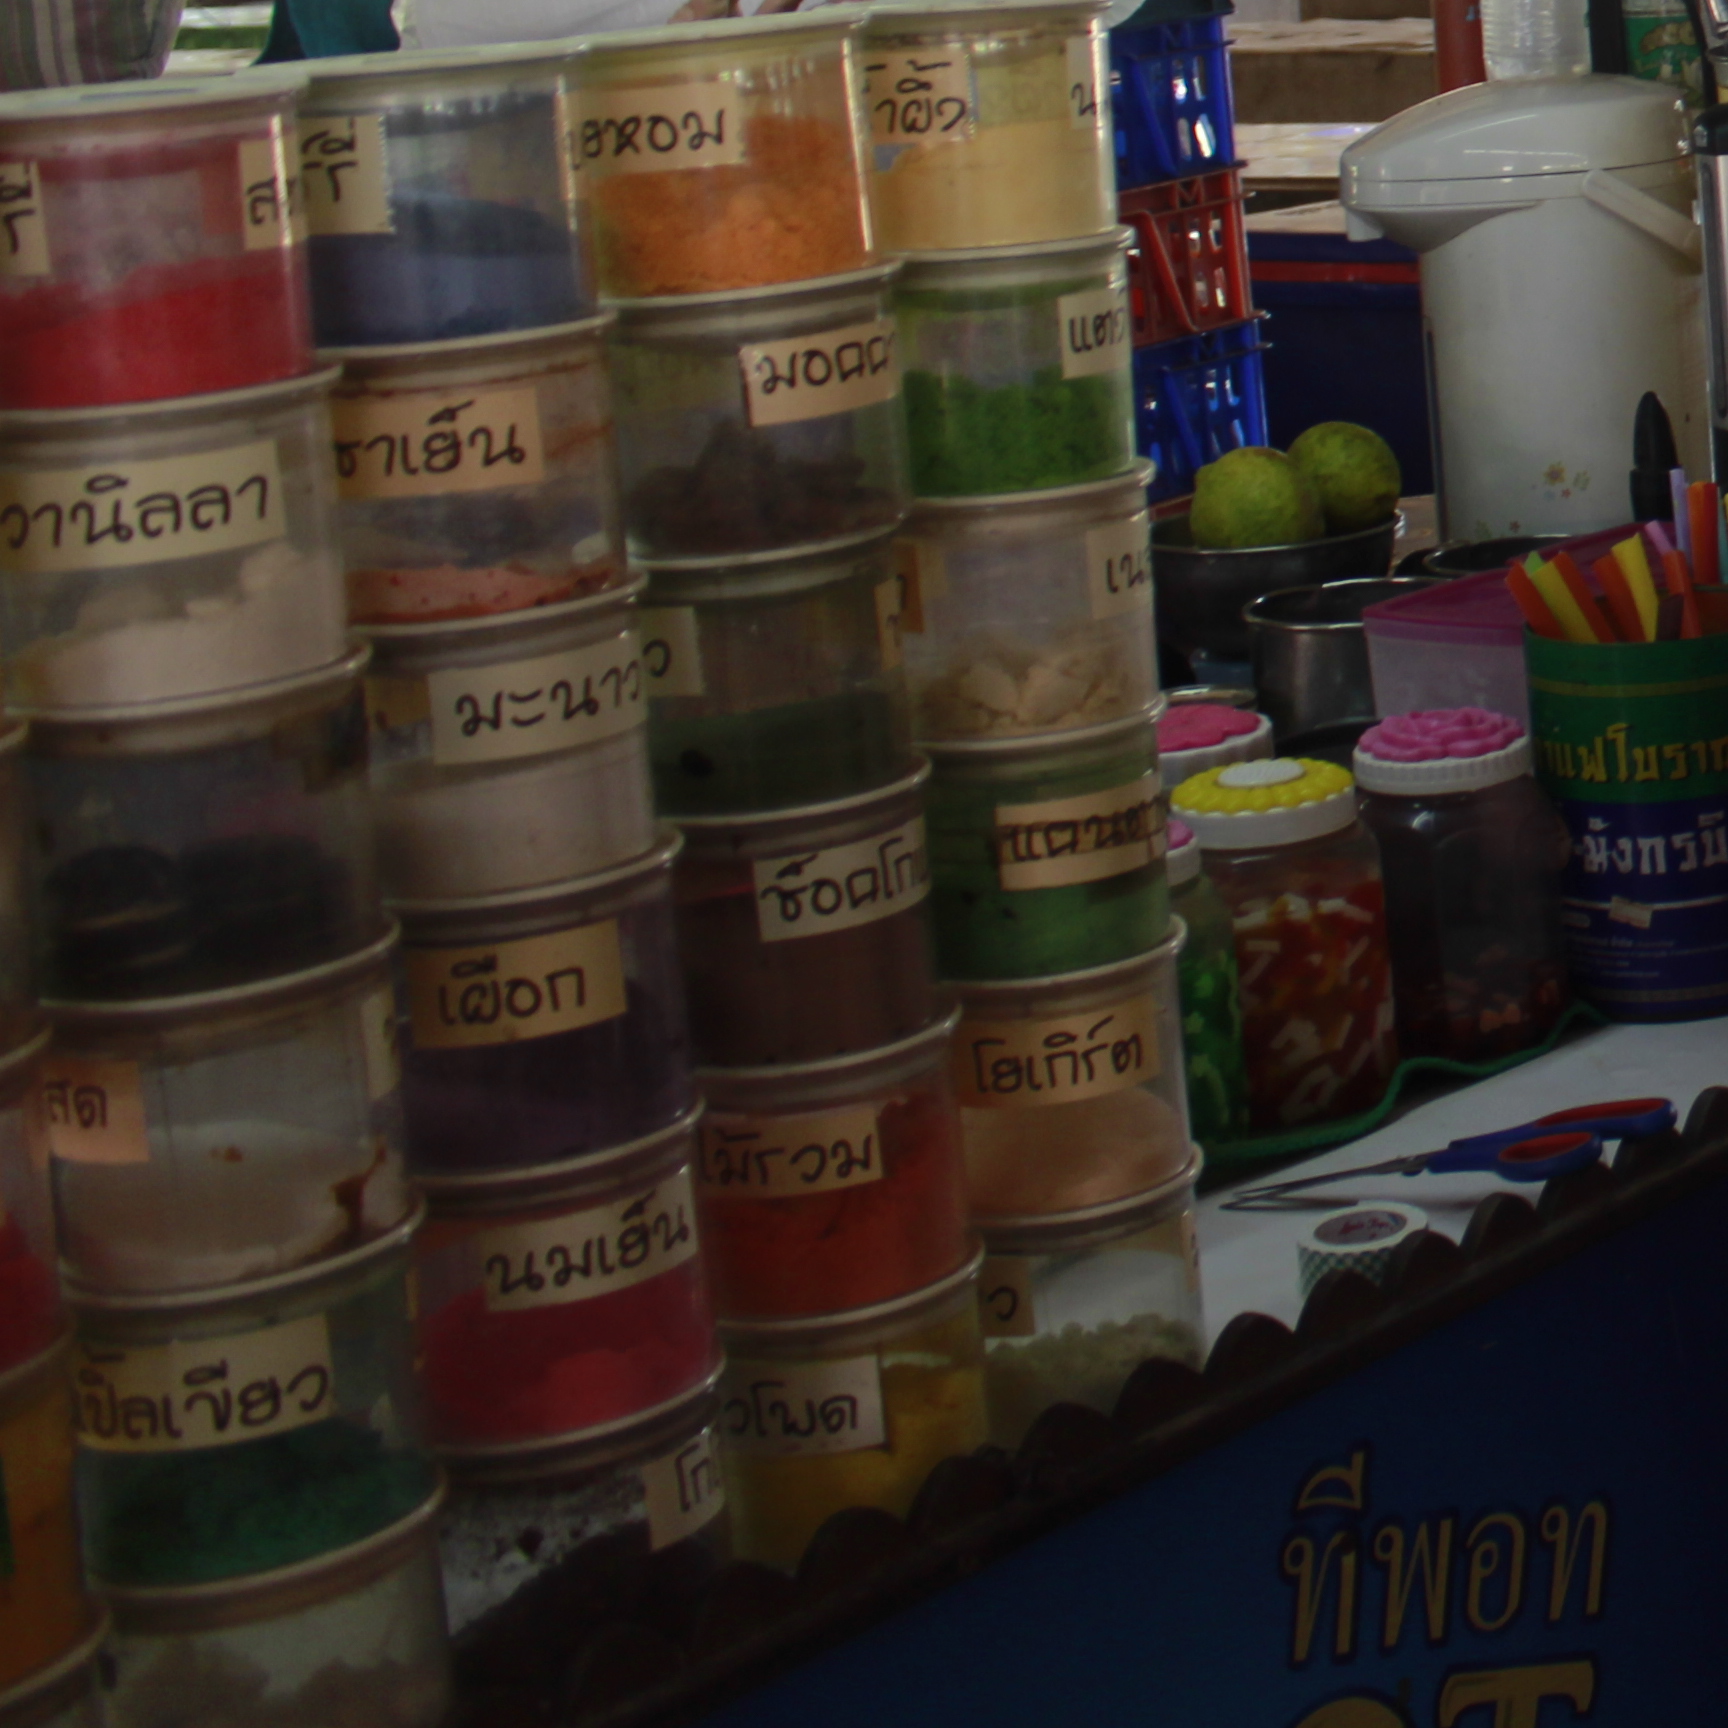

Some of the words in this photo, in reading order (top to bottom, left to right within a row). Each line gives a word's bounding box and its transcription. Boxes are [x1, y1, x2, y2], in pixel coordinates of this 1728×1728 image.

[0, 473, 268, 551] วานิลลา
[437, 954, 586, 1026] เผือก
[970, 1015, 1144, 1094] โยเกิร์ต
[486, 1189, 689, 1294] นมเย็น
[1283, 1450, 1608, 1662] ทีพอท
